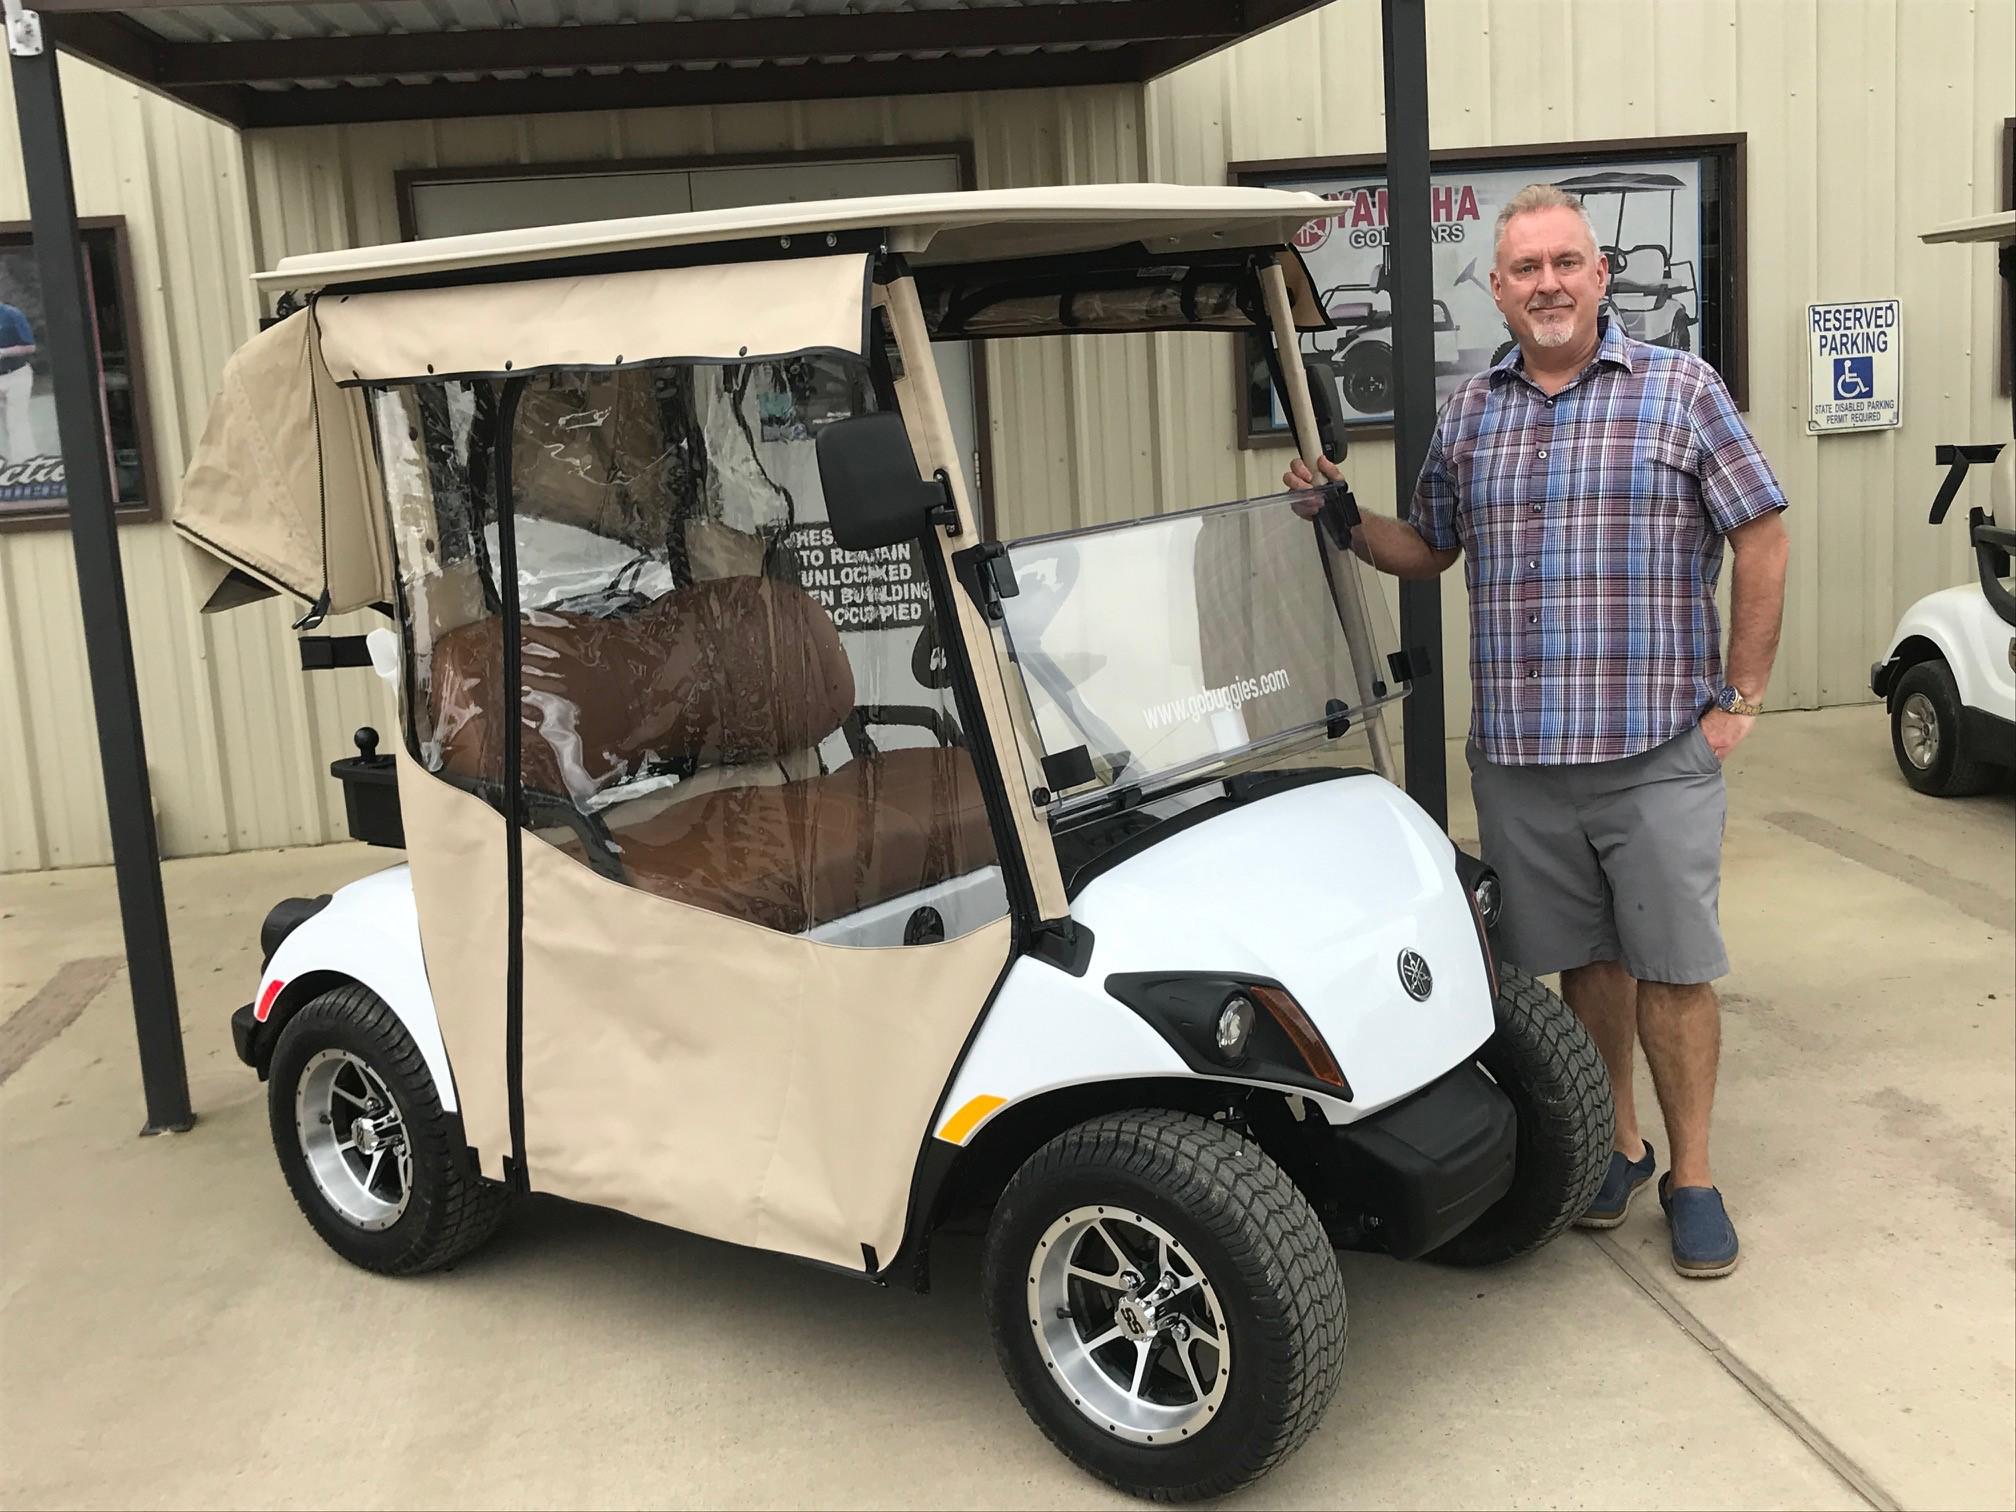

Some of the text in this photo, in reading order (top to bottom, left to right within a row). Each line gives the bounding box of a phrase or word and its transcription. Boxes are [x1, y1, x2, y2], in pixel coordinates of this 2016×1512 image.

[1328, 185, 1480, 228] YAHA
[1351, 225, 1464, 248] GOL RS
[1812, 306, 1895, 332] RESERVED
[1819, 330, 1888, 356] PARKING
[1815, 400, 1894, 414] STATE DISABLED PARKING
[1827, 413, 1848, 424] PERMIT
[1851, 411, 1880, 422] REQUIRED
[785, 527, 834, 549] HES
[800, 543, 911, 567] TO REMAIN
[801, 563, 912, 587] UNLOCKED
[808, 589, 834, 606] EN
[1143, 668, 1290, 729] www.gobuggies.com
